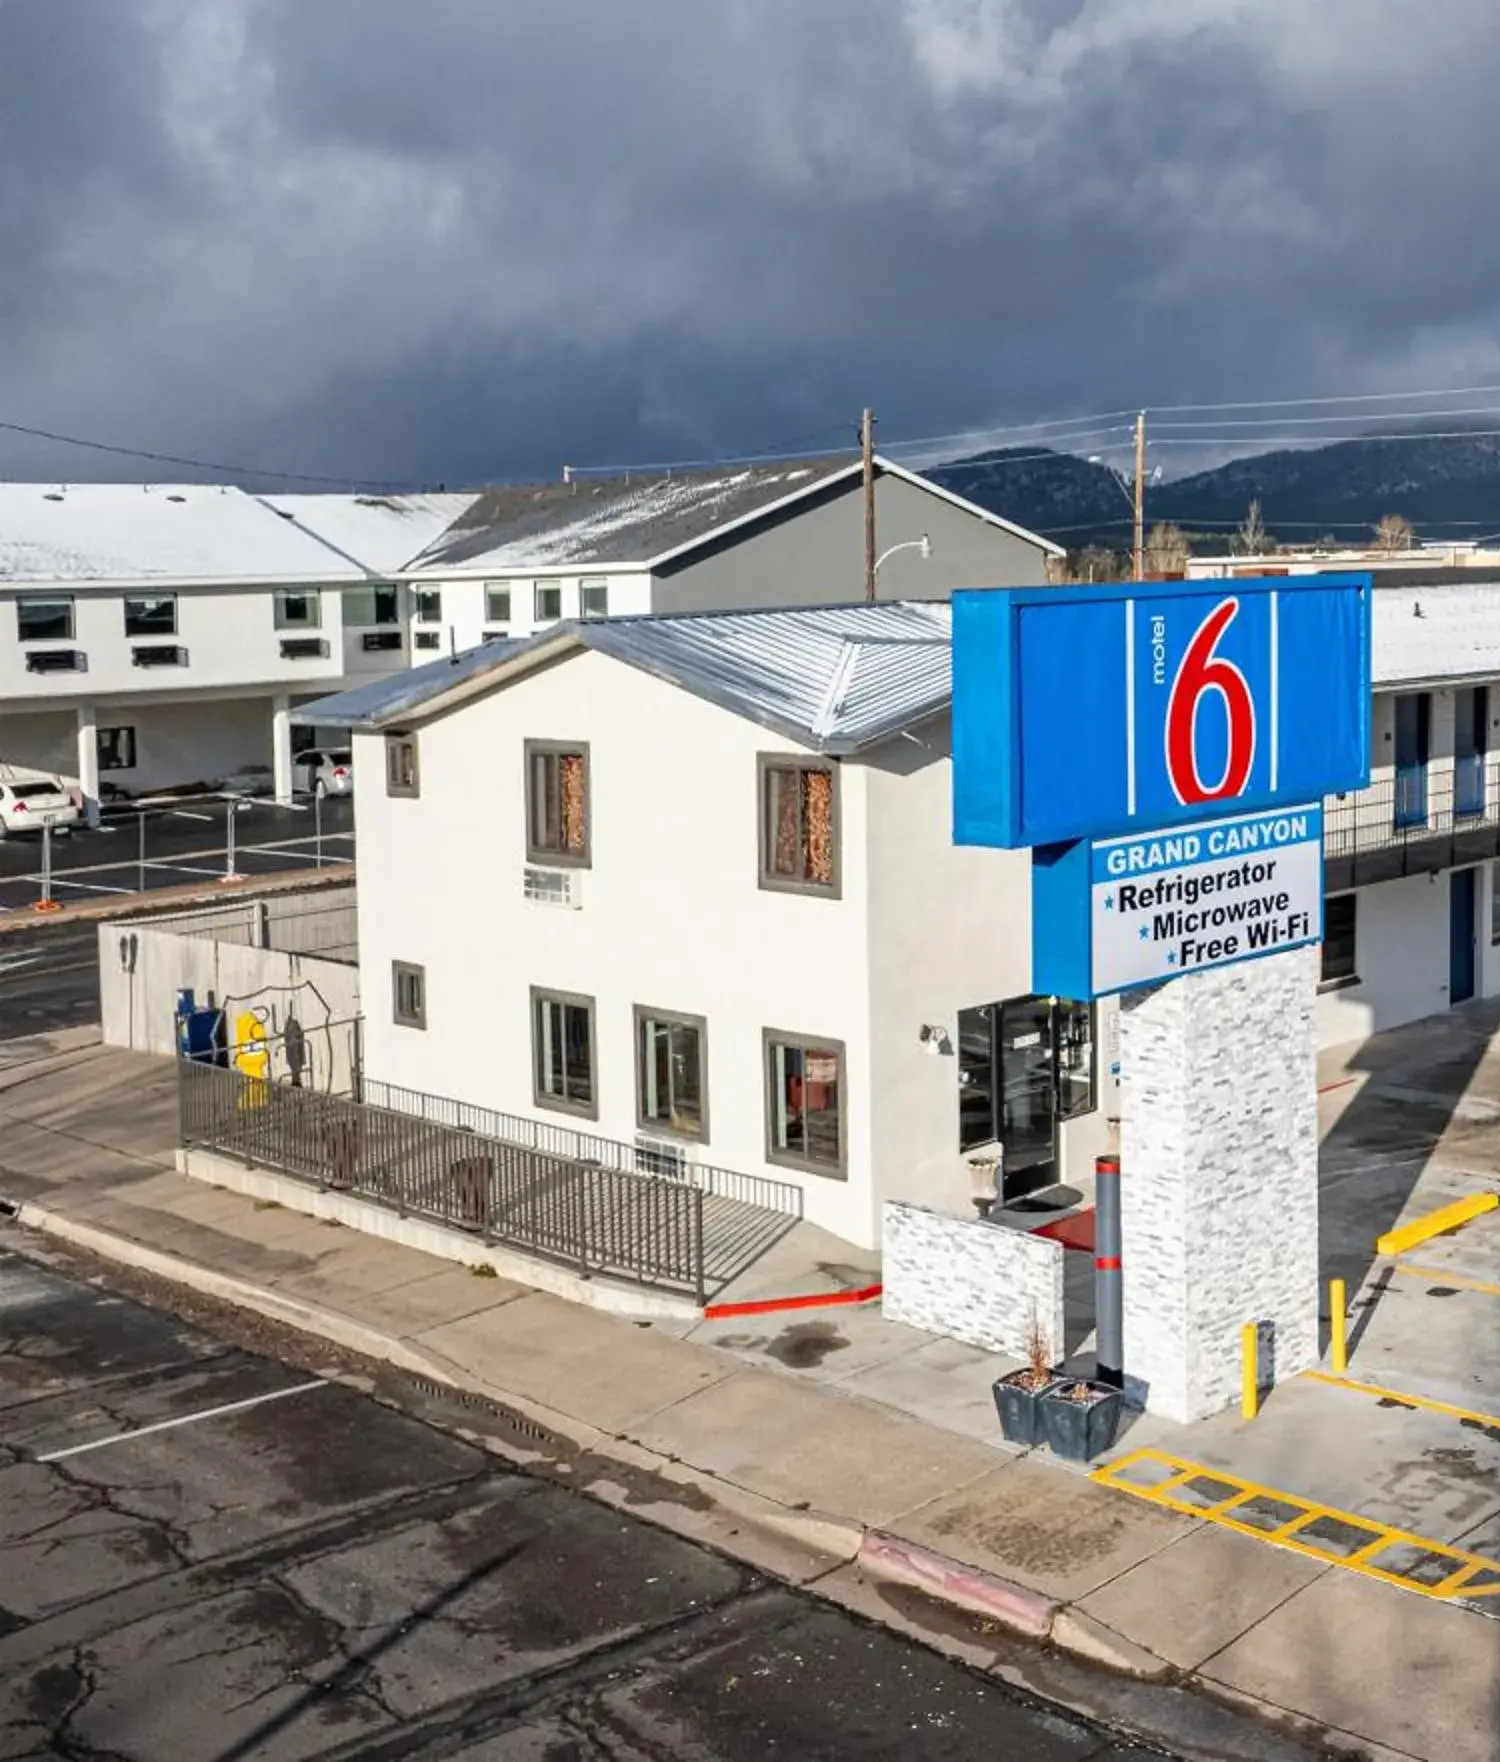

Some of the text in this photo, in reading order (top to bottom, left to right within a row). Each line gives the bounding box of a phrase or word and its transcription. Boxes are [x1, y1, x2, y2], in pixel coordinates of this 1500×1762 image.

[1151, 615, 1165, 685] motel
[1164, 595, 1257, 806] 6
[1107, 816, 1307, 875] GRAND CANYON
[1119, 861, 1277, 913] Refrigerator
[1153, 892, 1289, 941] Microwave
[1180, 912, 1310, 967] Free Wi-Fi
